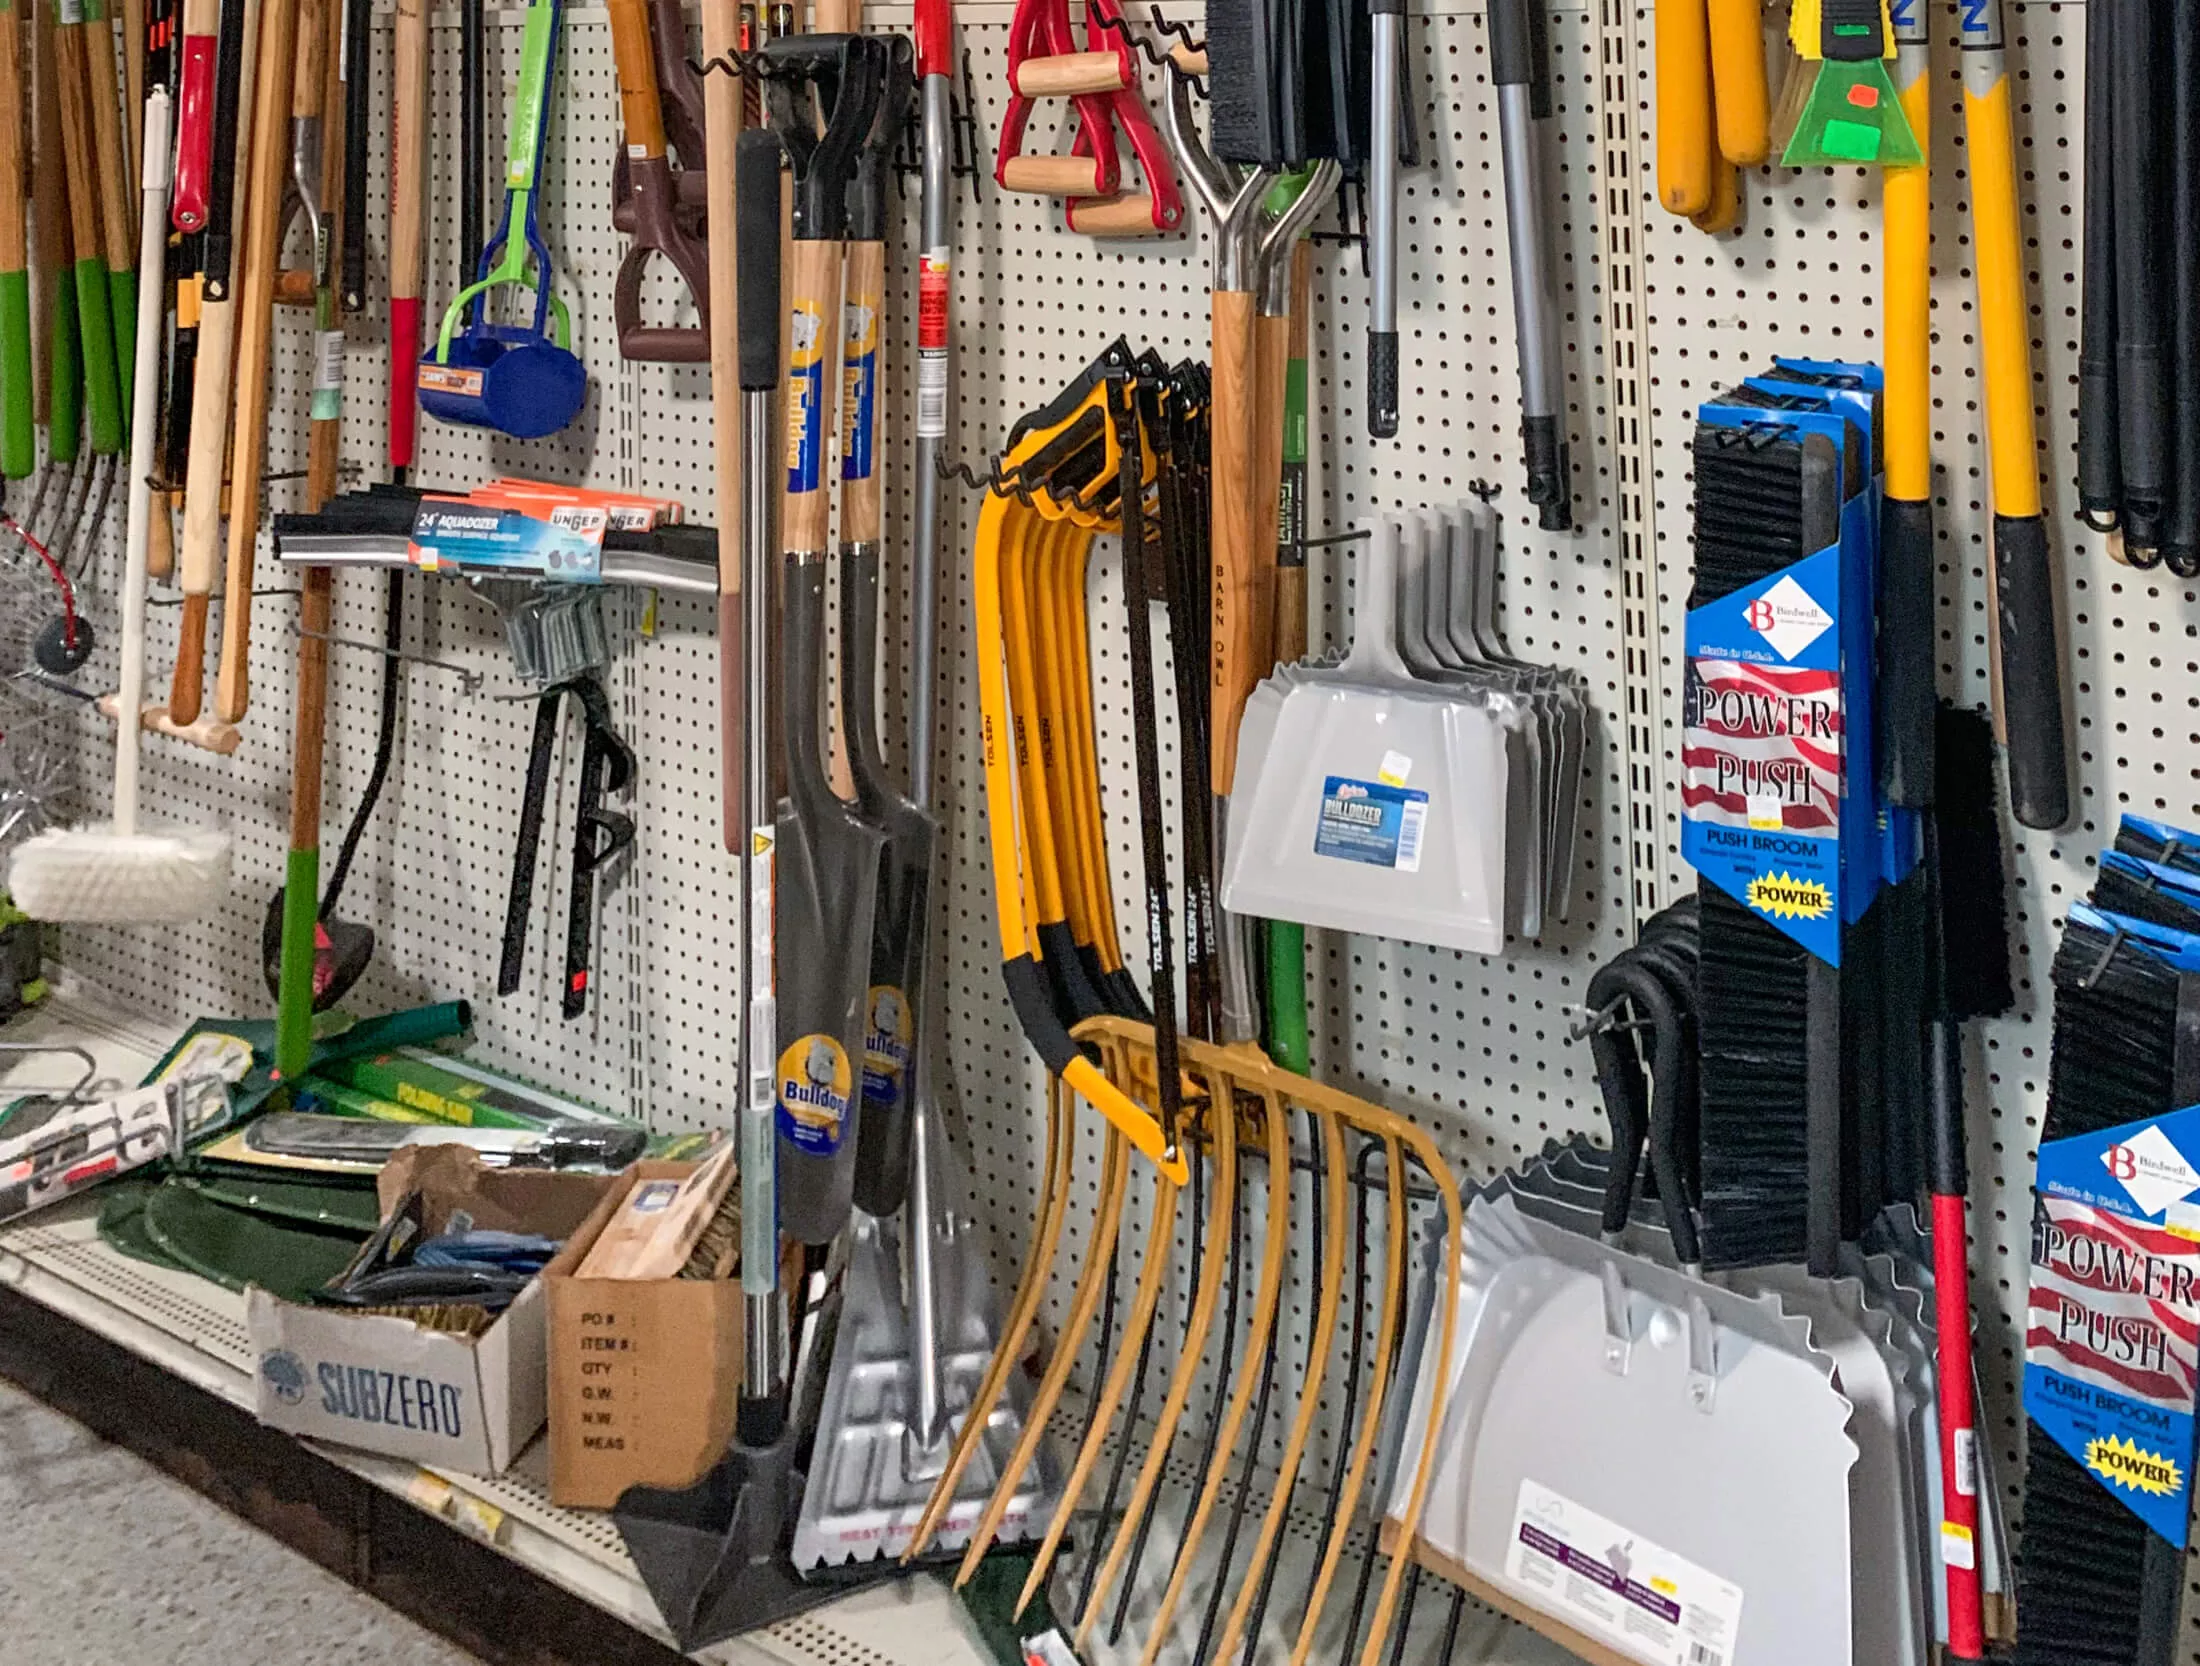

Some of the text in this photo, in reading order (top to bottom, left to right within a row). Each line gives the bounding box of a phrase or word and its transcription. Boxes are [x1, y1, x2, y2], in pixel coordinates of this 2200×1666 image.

[609, 513, 645, 531] NGER
[1214, 564, 1225, 688] BARN OWL
[1776, 605, 1819, 619] Birdwell
[1695, 686, 1833, 740] POWER
[1715, 754, 1813, 806] PUSH
[1706, 828, 1748, 849] PUSH
[1752, 835, 1819, 857] BROOM
[1756, 885, 1823, 908] POWER
[1151, 912, 1163, 973] TOLSEN
[1187, 911, 1198, 965] TOLSEN
[866, 1034, 909, 1061] ulldog
[784, 1079, 848, 1122] Bulldog
[2138, 1154, 2187, 1177] Birdwell
[2040, 1222, 2194, 1308] POWER
[581, 1311, 603, 1326] PO
[2058, 1298, 2168, 1373] PUSH
[581, 1336, 617, 1351] ITEM
[317, 1360, 462, 1439] SUBZERO
[2044, 1374, 2091, 1404] PUSH
[2094, 1393, 2171, 1432] BROOM
[582, 1436, 626, 1451] MEAS
[2095, 1446, 2172, 1486] POWER
